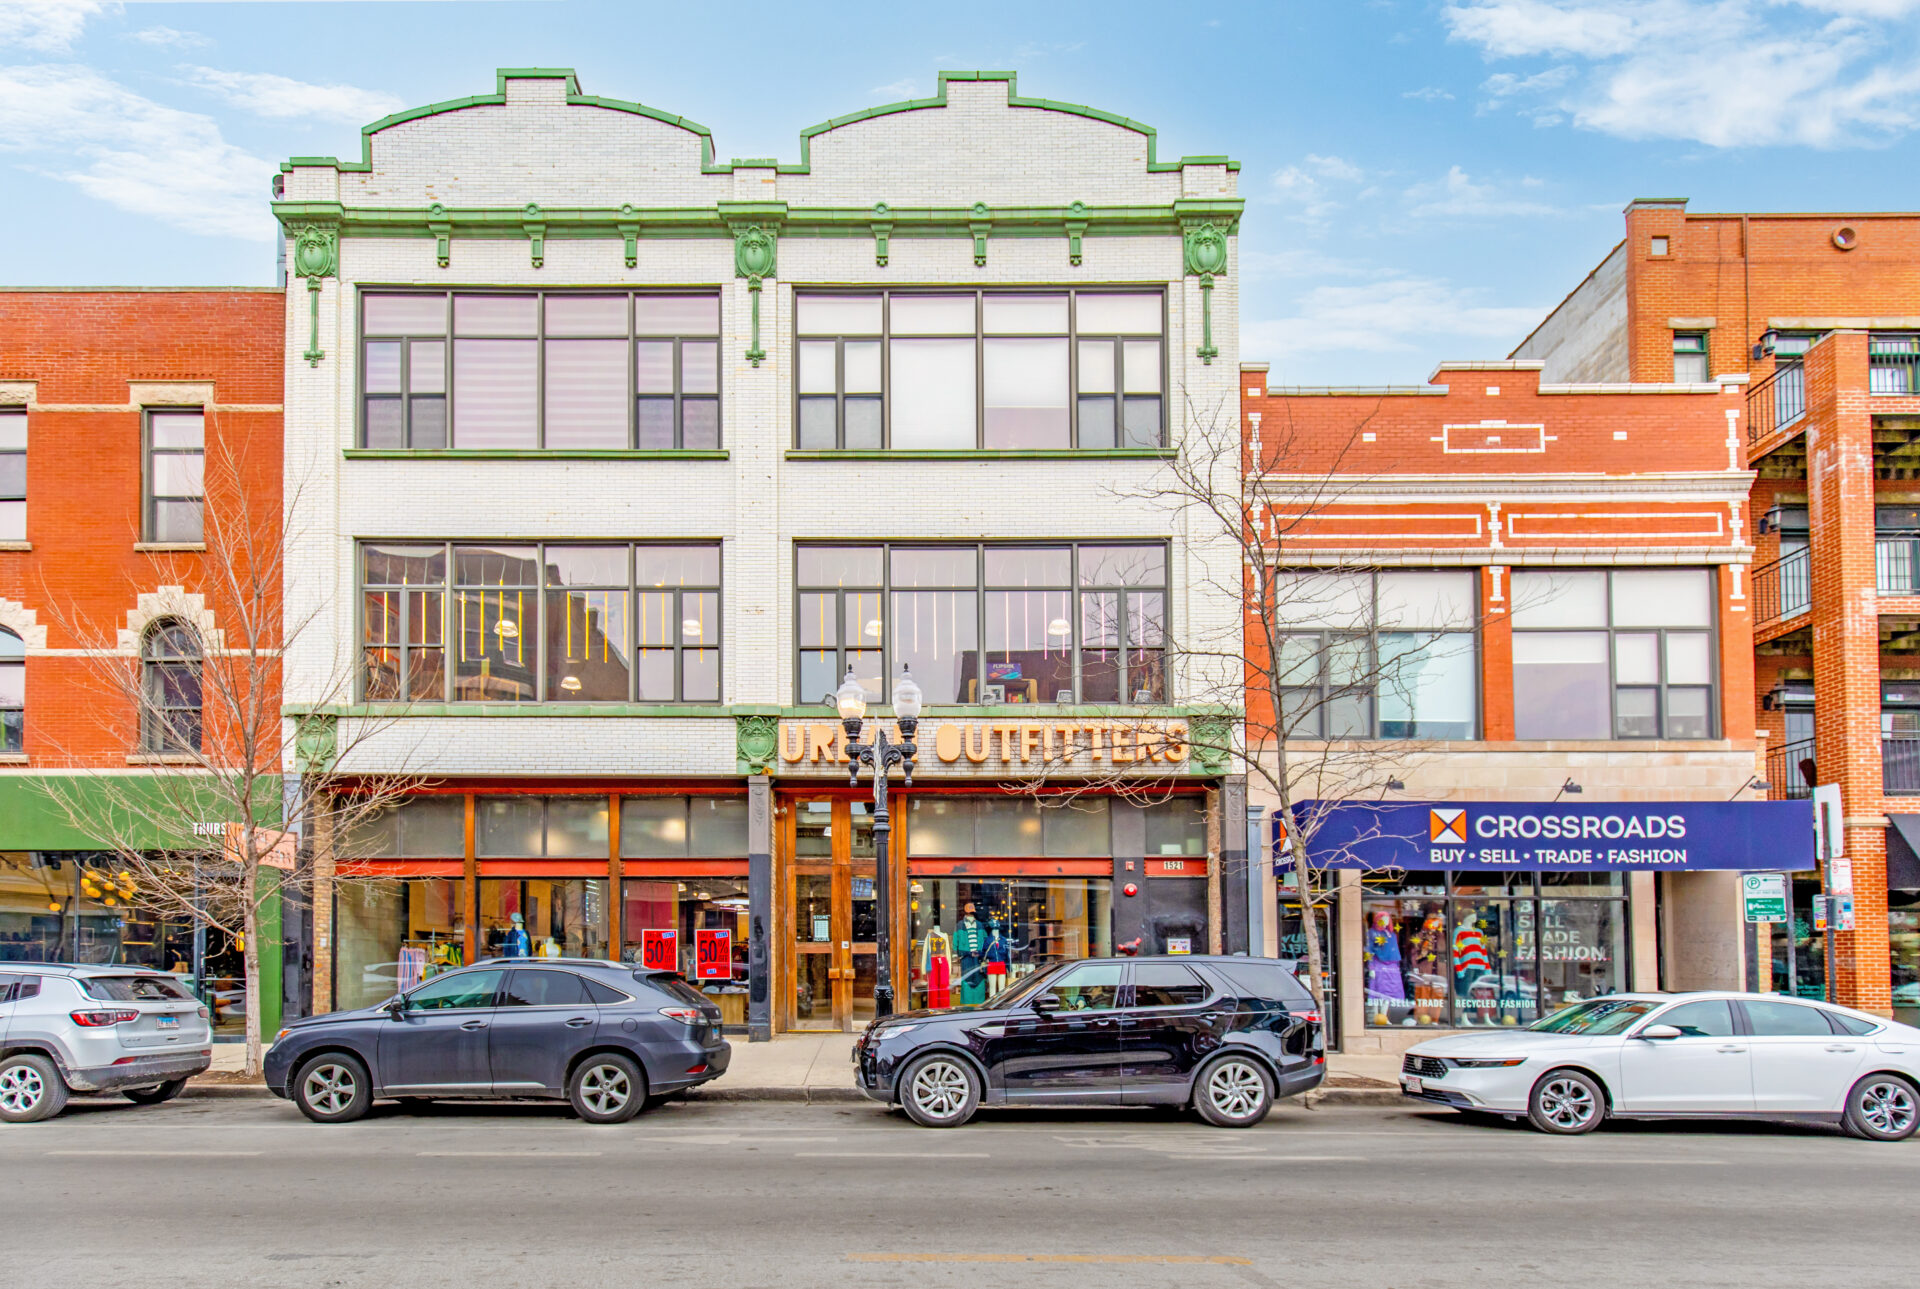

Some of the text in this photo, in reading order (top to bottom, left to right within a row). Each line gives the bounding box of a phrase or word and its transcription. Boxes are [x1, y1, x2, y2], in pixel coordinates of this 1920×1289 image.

[936, 723, 1190, 763] OUTFITTERS
[1475, 815, 1686, 838] CROSSROADS
[1430, 849, 1687, 863] BUY SELL TRADE FASHION
[1164, 861, 1183, 869] 1521
[1519, 915, 1565, 928] SLL
[1367, 998, 1444, 1008] BUY SELL TRADE
[1455, 999, 1536, 1008] RECYCLED FASHION
